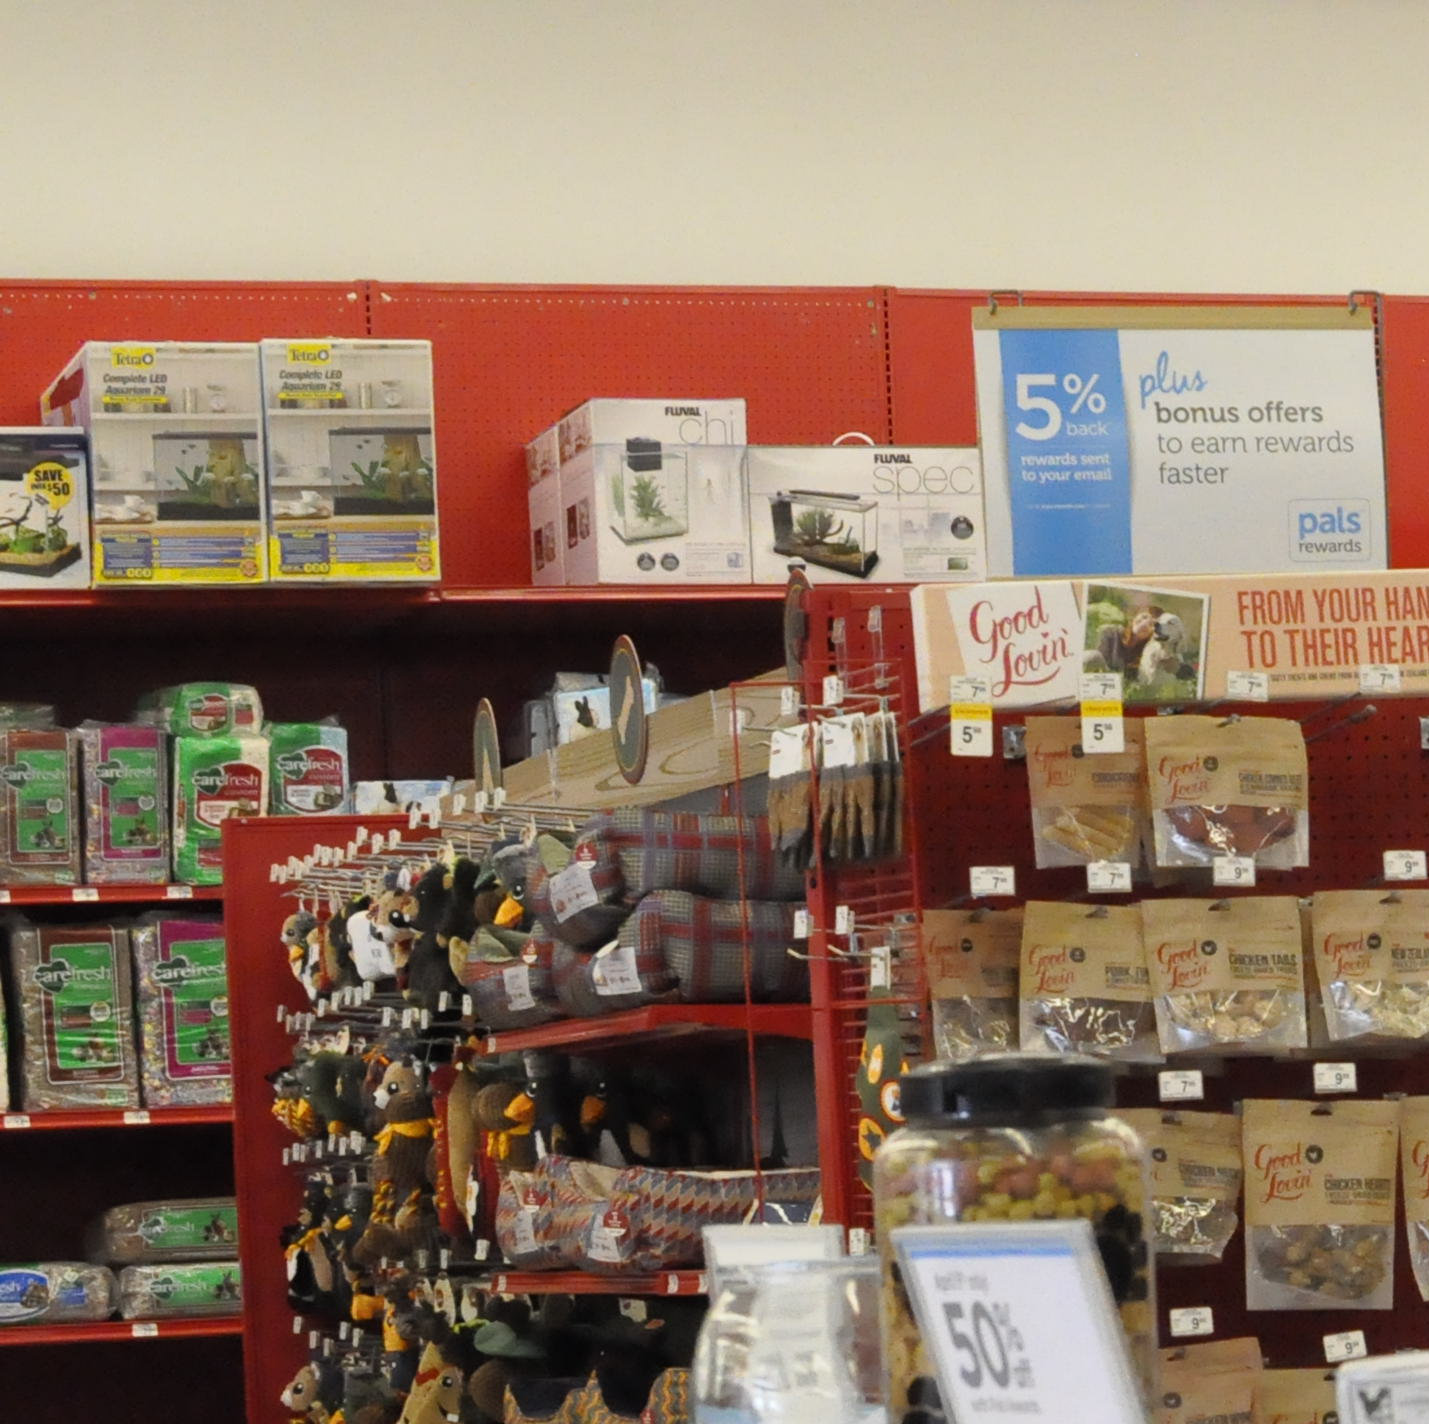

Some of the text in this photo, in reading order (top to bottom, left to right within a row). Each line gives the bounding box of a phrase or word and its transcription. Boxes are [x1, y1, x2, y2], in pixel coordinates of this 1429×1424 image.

[115, 352, 143, 366] Tetra
[291, 349, 317, 362] Tetra
[103, 373, 167, 385] Complete LED
[279, 370, 342, 380] Complete LED
[1138, 350, 1208, 409] plus
[105, 386, 151, 396] Aquarium
[282, 381, 327, 391] Aquarium
[664, 407, 702, 418] FLUVAL
[1014, 372, 1108, 442] 5%
[1154, 400, 1324, 424] bonus offers
[678, 410, 736, 445] chi
[1066, 421, 1109, 437] back
[1157, 430, 1356, 454] to earn rewards
[873, 453, 913, 464] FLUVAL
[1020, 453, 1110, 467] rewards sent
[34, 469, 63, 482] SAVE
[1021, 467, 1113, 485] to your email
[1158, 461, 1230, 486] faster
[872, 464, 975, 502] spec
[1298, 506, 1362, 540] pals
[1298, 538, 1363, 554] rewards
[1237, 589, 1305, 626] FROM
[1313, 587, 1378, 623] YOUR
[968, 585, 1050, 663] Good
[1240, 628, 1277, 669] TO
[1283, 627, 1360, 667] THEIR
[95, 764, 159, 781] carefresh
[276, 756, 341, 772] carefresh
[2, 765, 66, 783] carefresh
[192, 770, 259, 788] carefresh
[1156, 939, 1198, 975] Good
[33, 963, 113, 983] carefresh
[1254, 1142, 1302, 1180] Good
